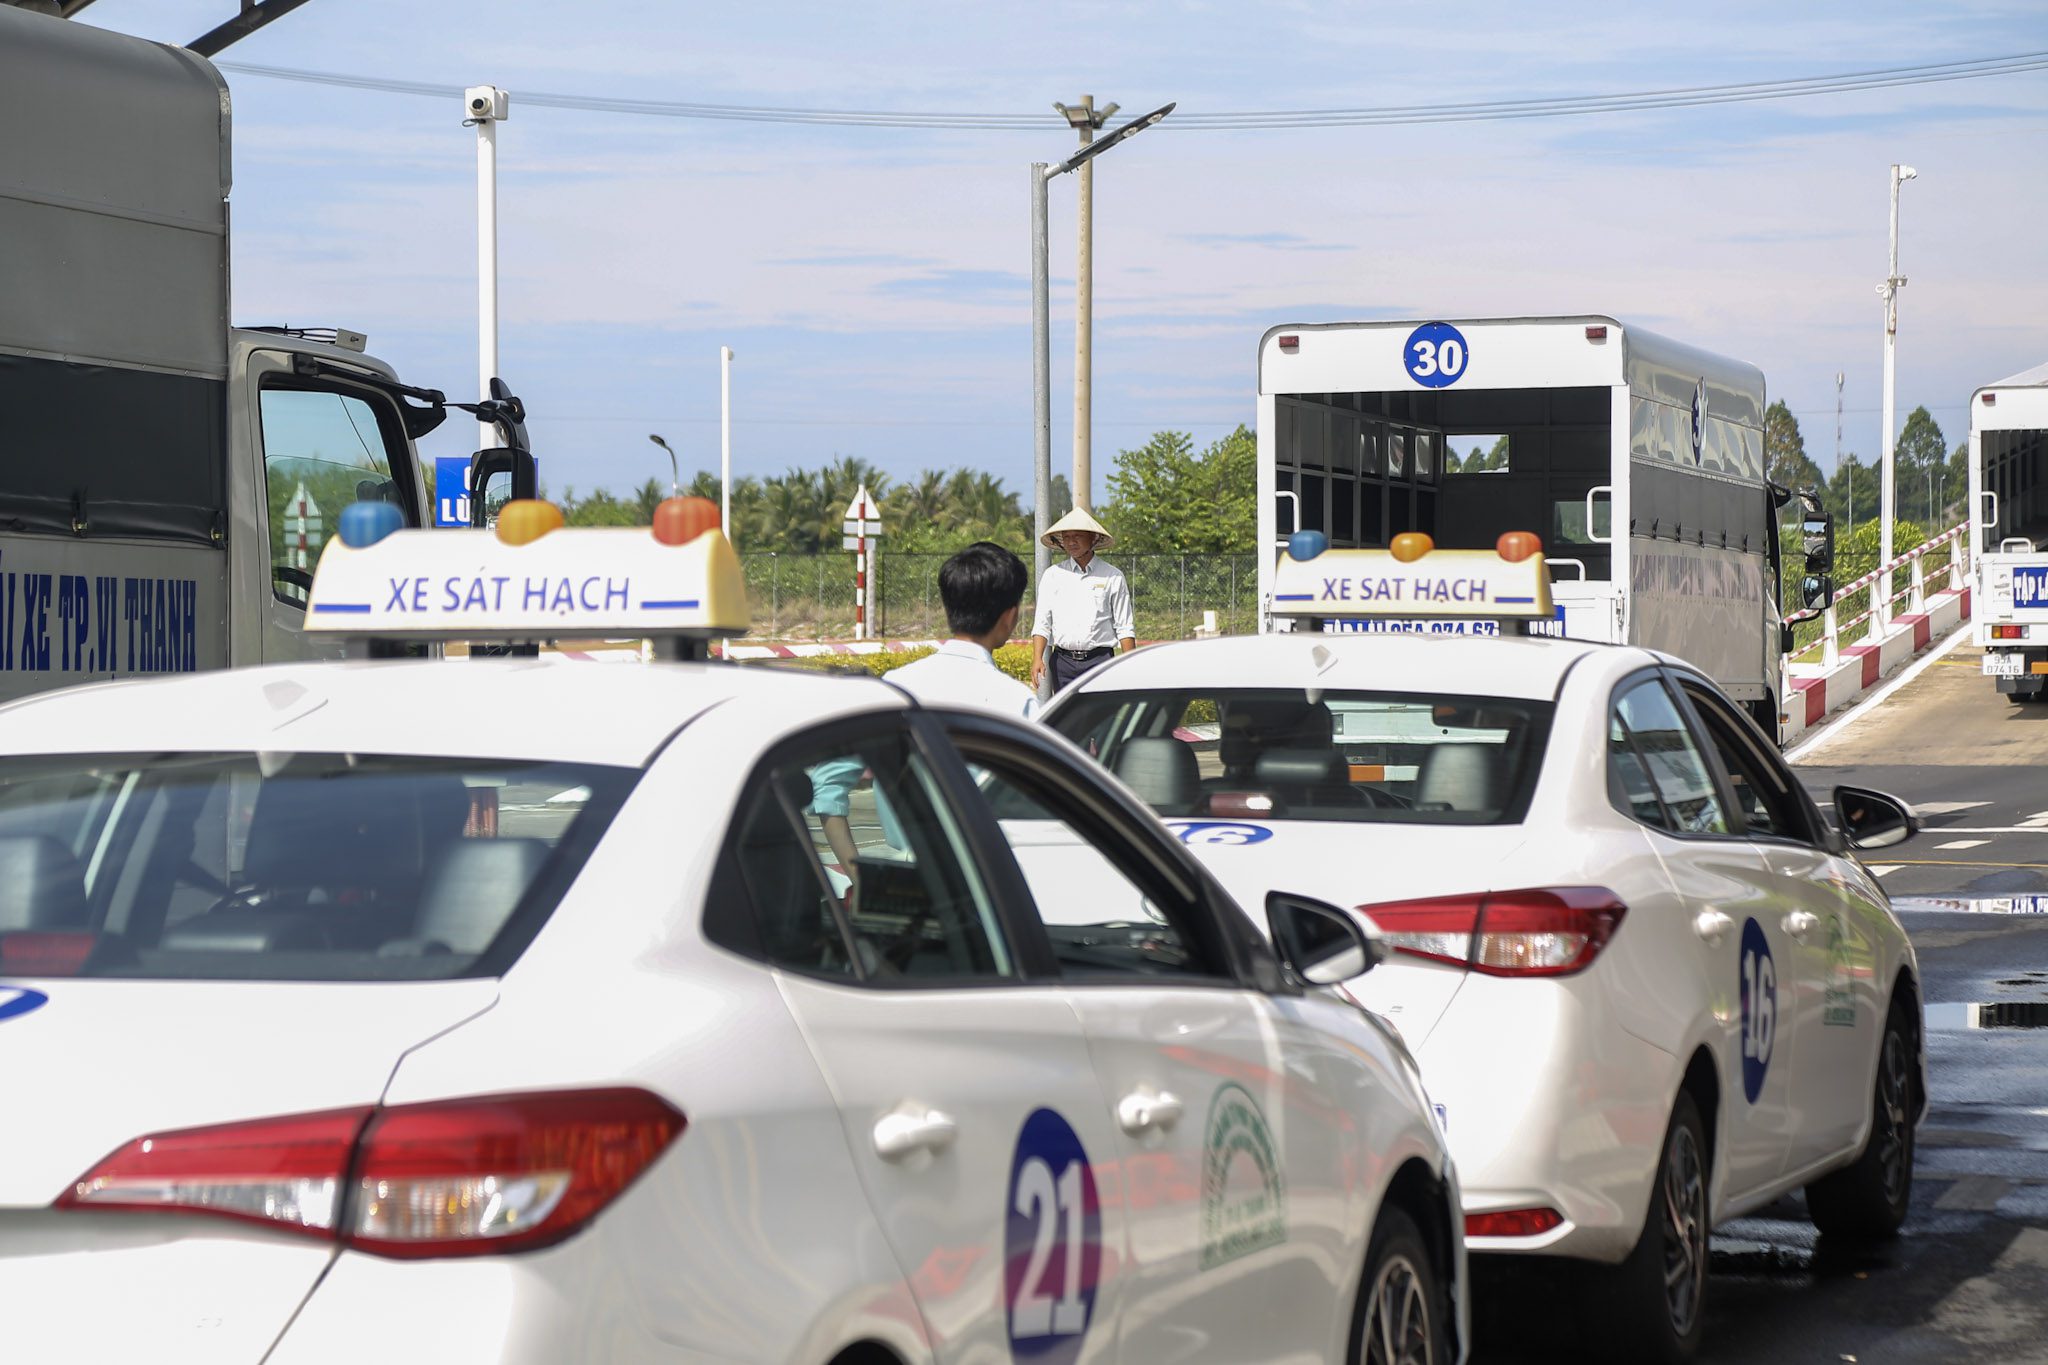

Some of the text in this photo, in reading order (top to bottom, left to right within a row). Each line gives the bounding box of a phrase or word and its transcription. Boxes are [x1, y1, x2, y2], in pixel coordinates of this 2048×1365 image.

[1413, 339, 1463, 377] 30
[21, 573, 52, 671] XE
[124, 577, 196, 672] THANH
[385, 565, 631, 616] XE SÁT HẠCH
[1321, 578, 1352, 601] XE
[1413, 578, 1487, 604] HẠCH
[1742, 949, 1775, 1065] 16
[1012, 1155, 1088, 1340] 21
